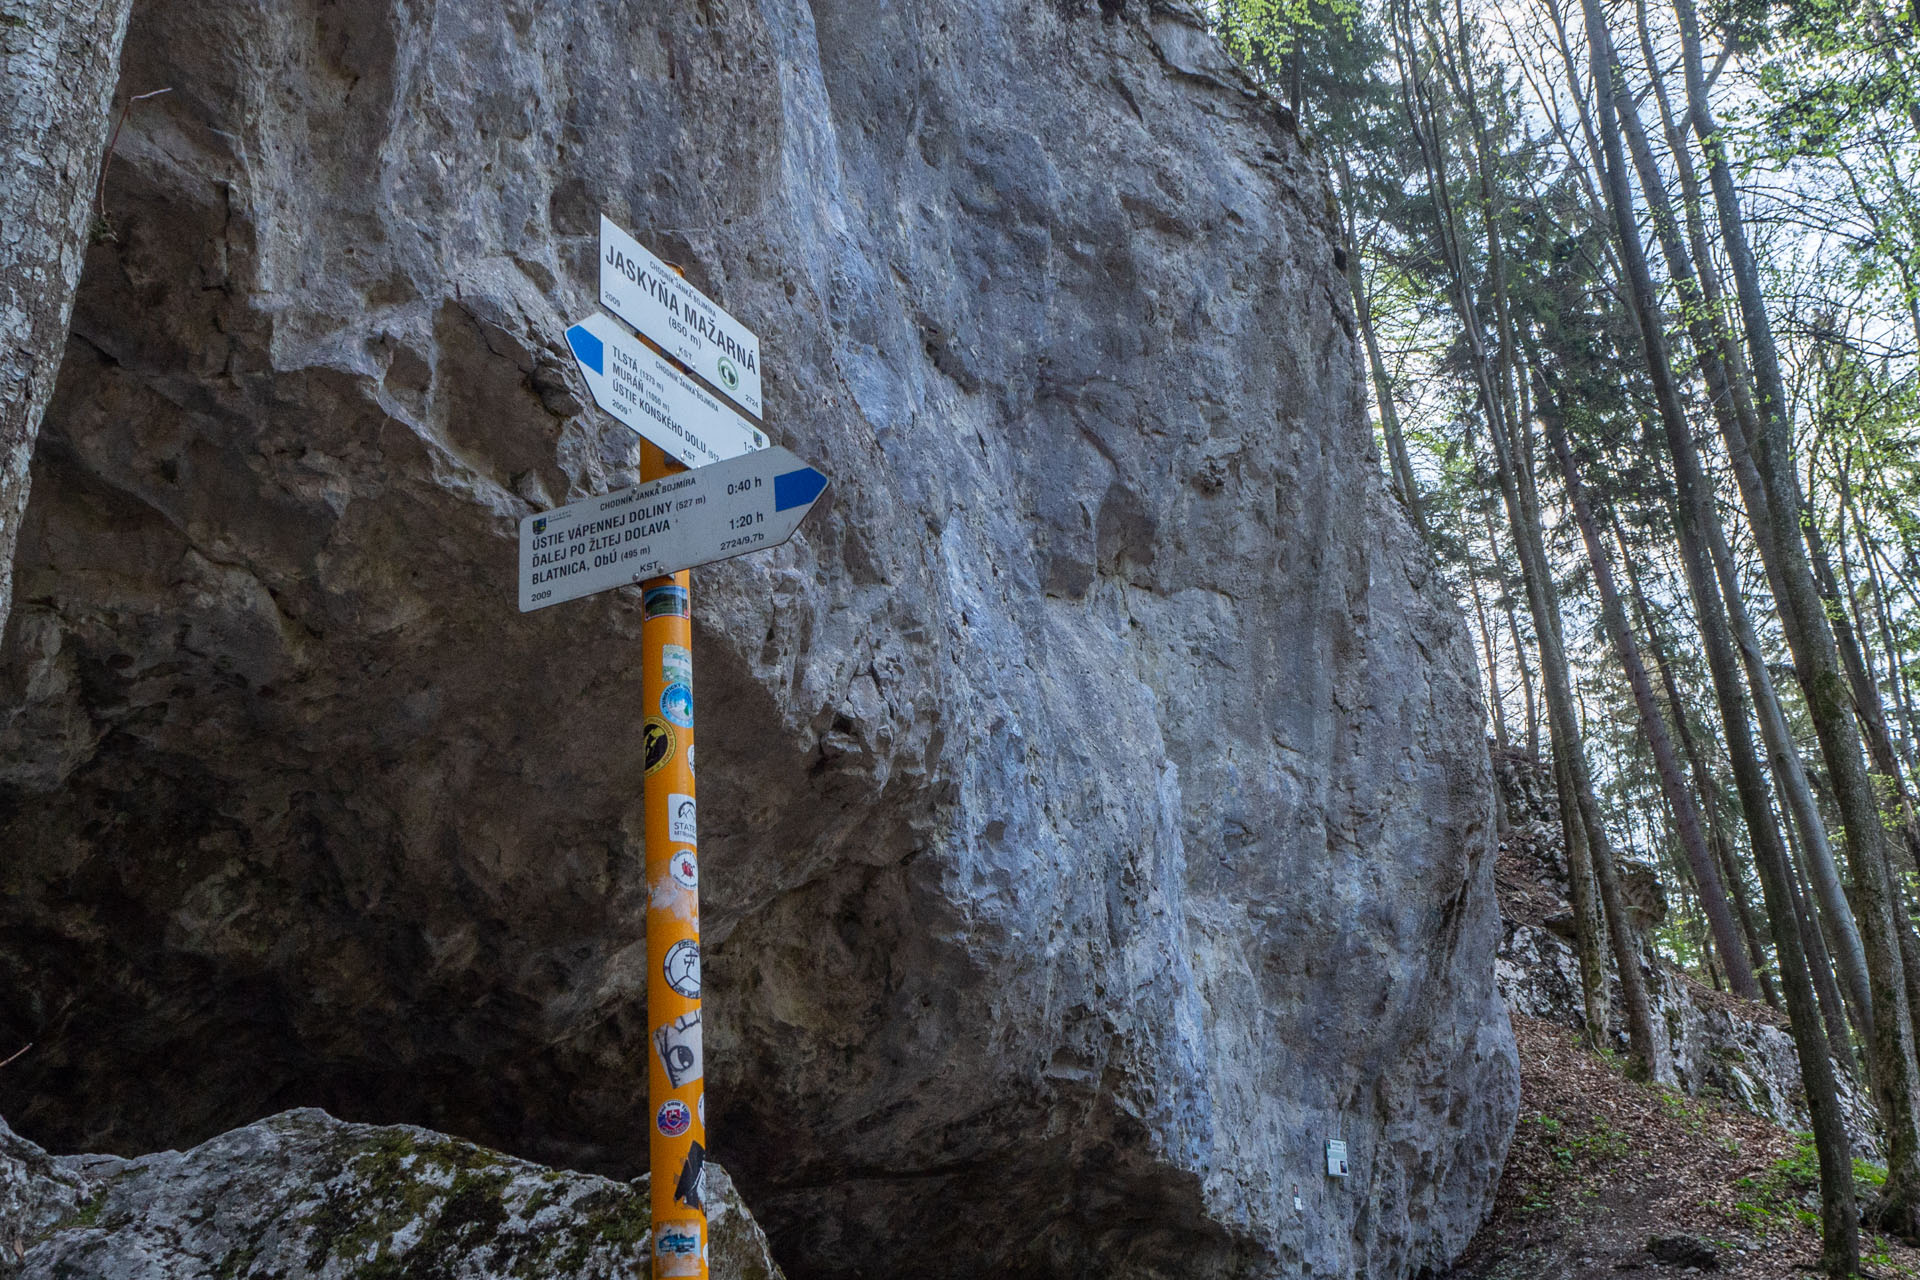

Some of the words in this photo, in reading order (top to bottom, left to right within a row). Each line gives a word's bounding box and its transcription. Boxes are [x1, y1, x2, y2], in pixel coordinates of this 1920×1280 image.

[605, 291, 621, 308] 2009
[606, 245, 679, 316] JASKYŇA
[685, 303, 756, 375] MAŽARNÁ
[668, 316, 688, 337] (850
[690, 334, 702, 350] m)
[679, 346, 692, 360] KST
[613, 345, 638, 373] TLSTÁ
[640, 369, 655, 386] (1373
[657, 382, 664, 393] m)
[613, 362, 643, 393] MURÁŇ
[663, 402, 670, 413] m)
[612, 399, 627, 415] 2009
[745, 394, 759, 409] 2724
[613, 378, 637, 405] ÚSTIE
[640, 398, 683, 437] KONSKÉHO
[685, 430, 706, 453] DOLU
[683, 448, 695, 461] KST
[600, 495, 633, 511] CHODNÍK
[636, 488, 659, 500] JANKA
[662, 477, 696, 494] BOJMÍRA
[727, 479, 751, 495] 0:40
[754, 476, 762, 488] h
[532, 531, 565, 551] ÚSTIE
[568, 515, 626, 540] VÁPENNEJ
[629, 501, 673, 523] DOLINY
[676, 498, 693, 512] (527
[695, 495, 706, 505] m)
[729, 513, 753, 530] 1:20
[756, 511, 764, 523] h
[532, 548, 567, 568] ĎALEJ
[570, 543, 585, 557] PO
[589, 533, 621, 552] ŽLTEJ
[625, 519, 670, 541] DOĽAVA
[532, 560, 590, 585] BLATNICA,
[594, 548, 617, 568] ObÚ
[621, 549, 638, 562] (495
[640, 545, 650, 555] m)
[640, 560, 658, 573] KST
[531, 590, 552, 602] 2009
